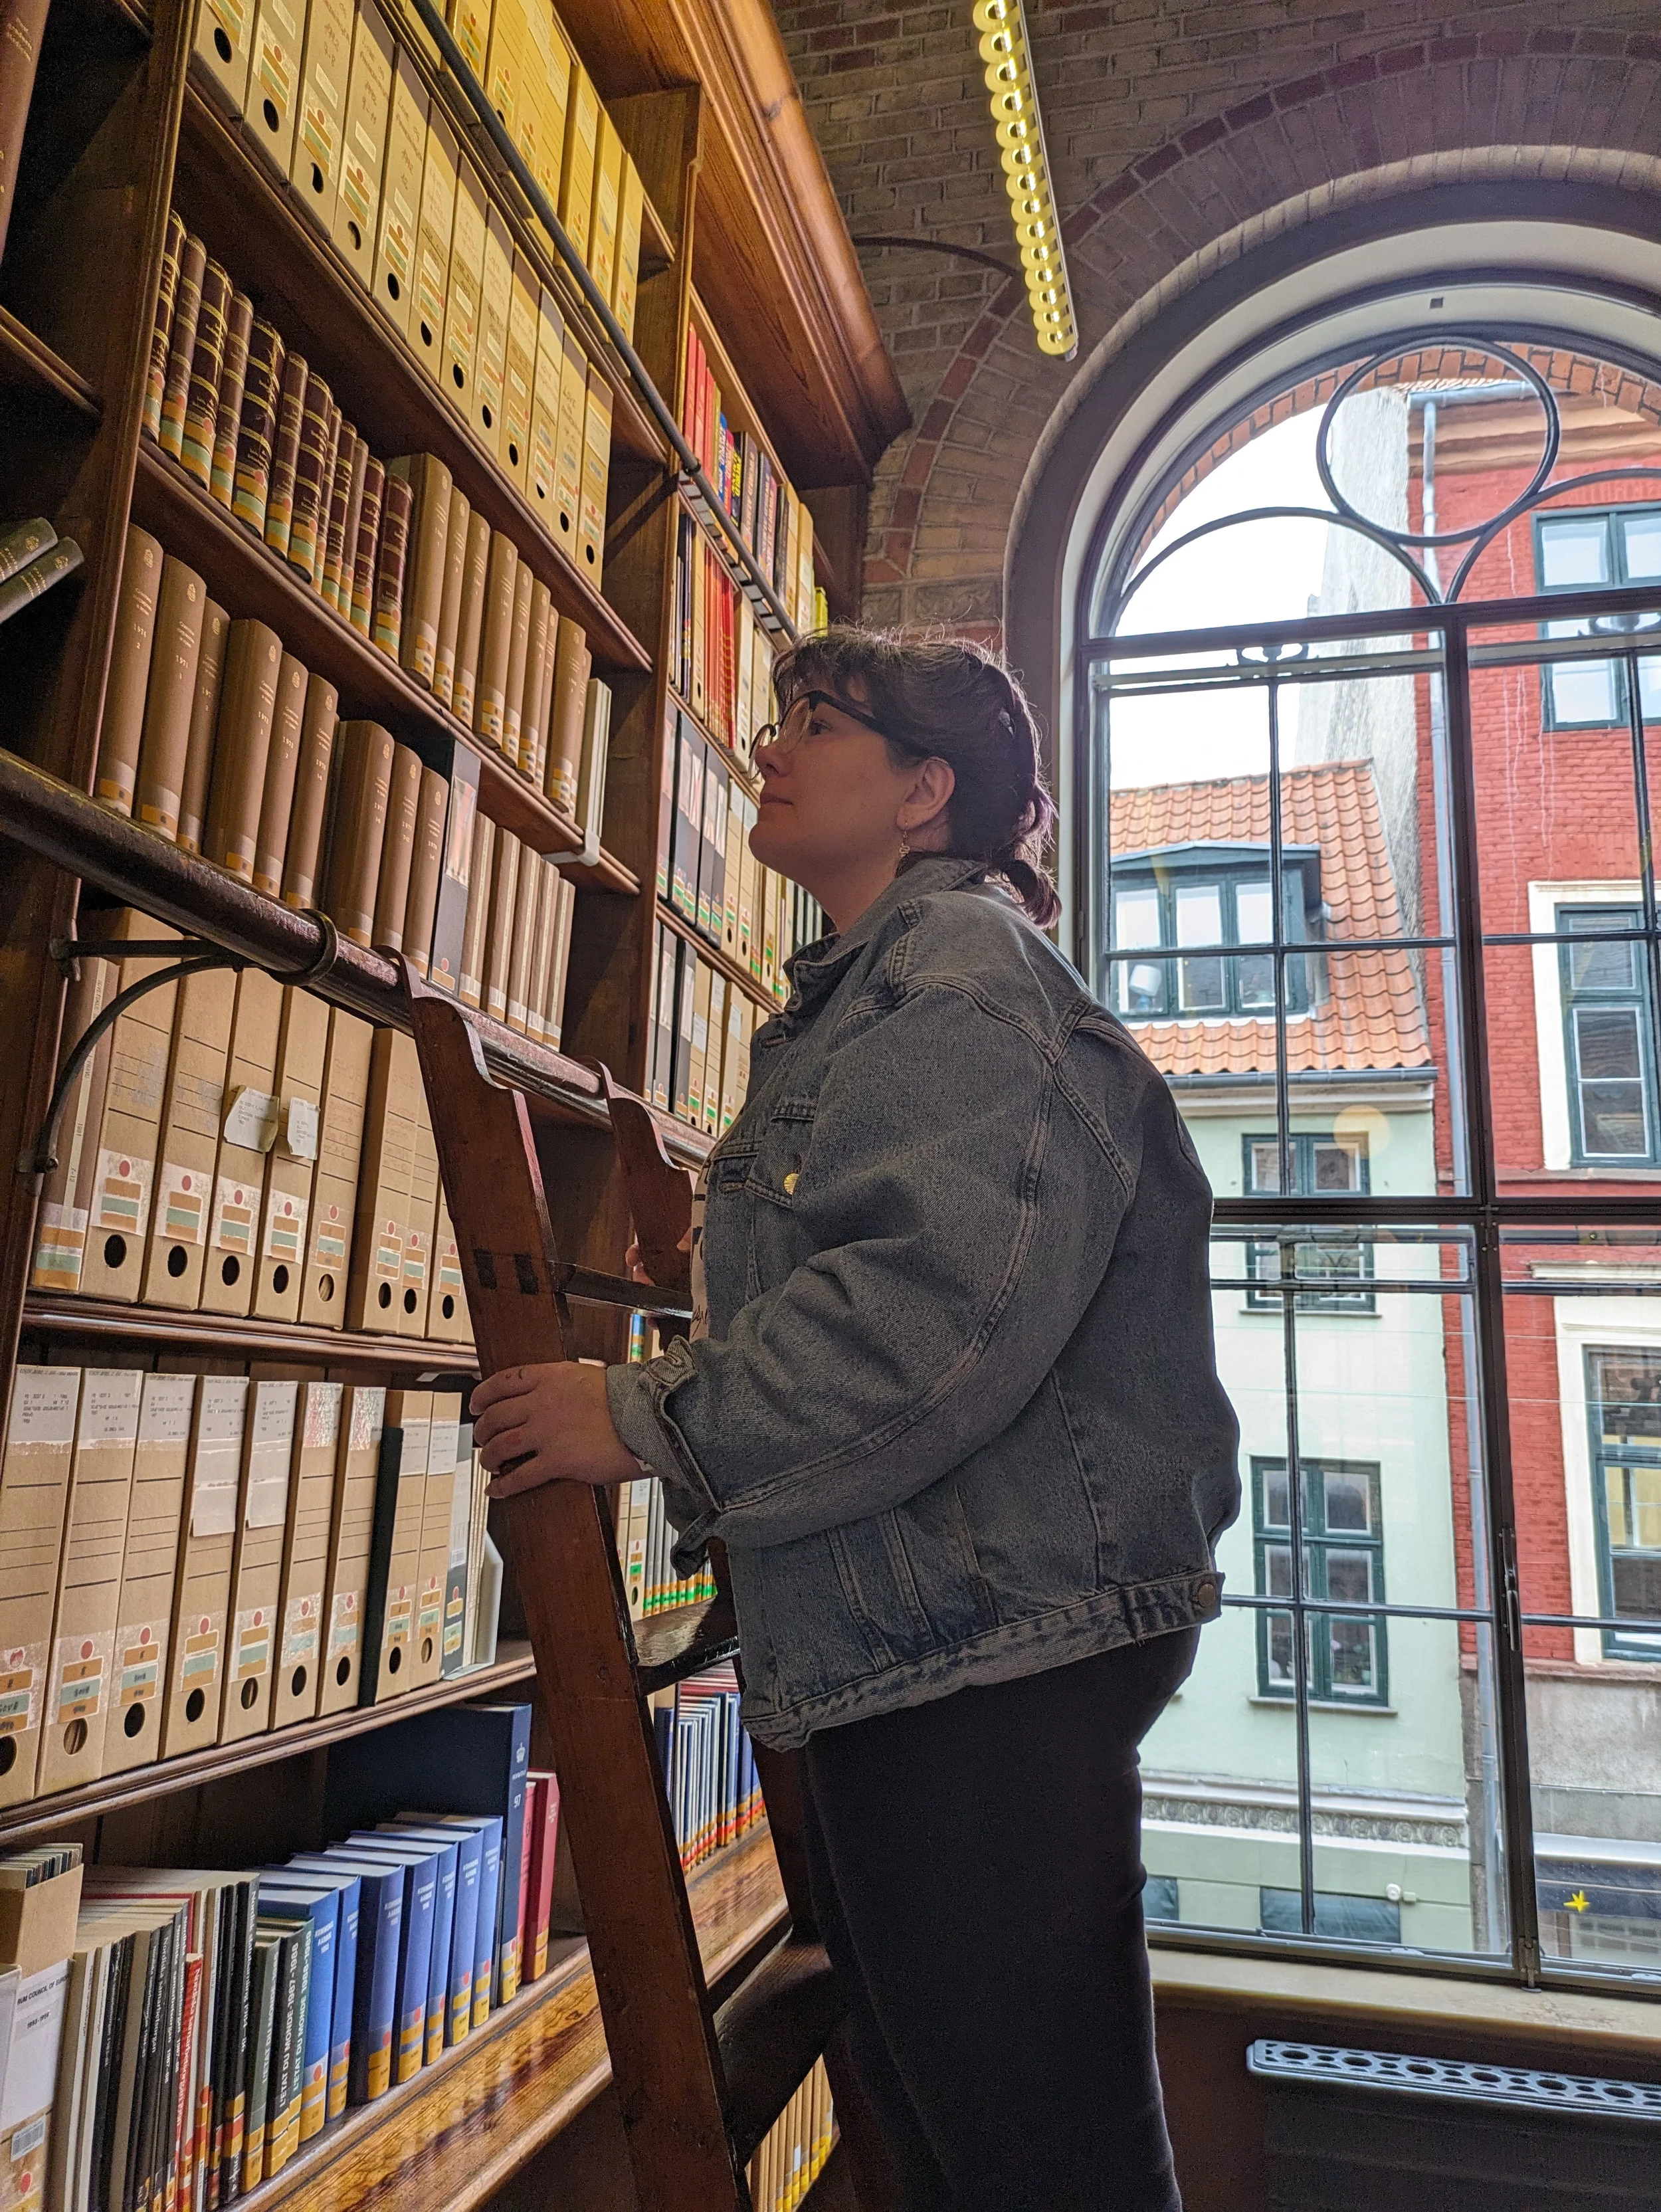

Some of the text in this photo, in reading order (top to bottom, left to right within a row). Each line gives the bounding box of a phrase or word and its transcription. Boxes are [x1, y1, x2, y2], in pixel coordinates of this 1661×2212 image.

[203, 688, 212, 698] 197
[514, 1794, 521, 1808] 97
[302, 1930, 312, 1993] 1988-1989
[29, 1986, 47, 2000] COUNCIL
[189, 1968, 201, 2015] Nordiska
[167, 1970, 177, 2043] samarbetsorgan
[298, 1997, 306, 2037] MONDE
[296, 2040, 303, 2055] DU
[283, 2053, 290, 2070] DU
[280, 2074, 288, 2108] L'ETAT
